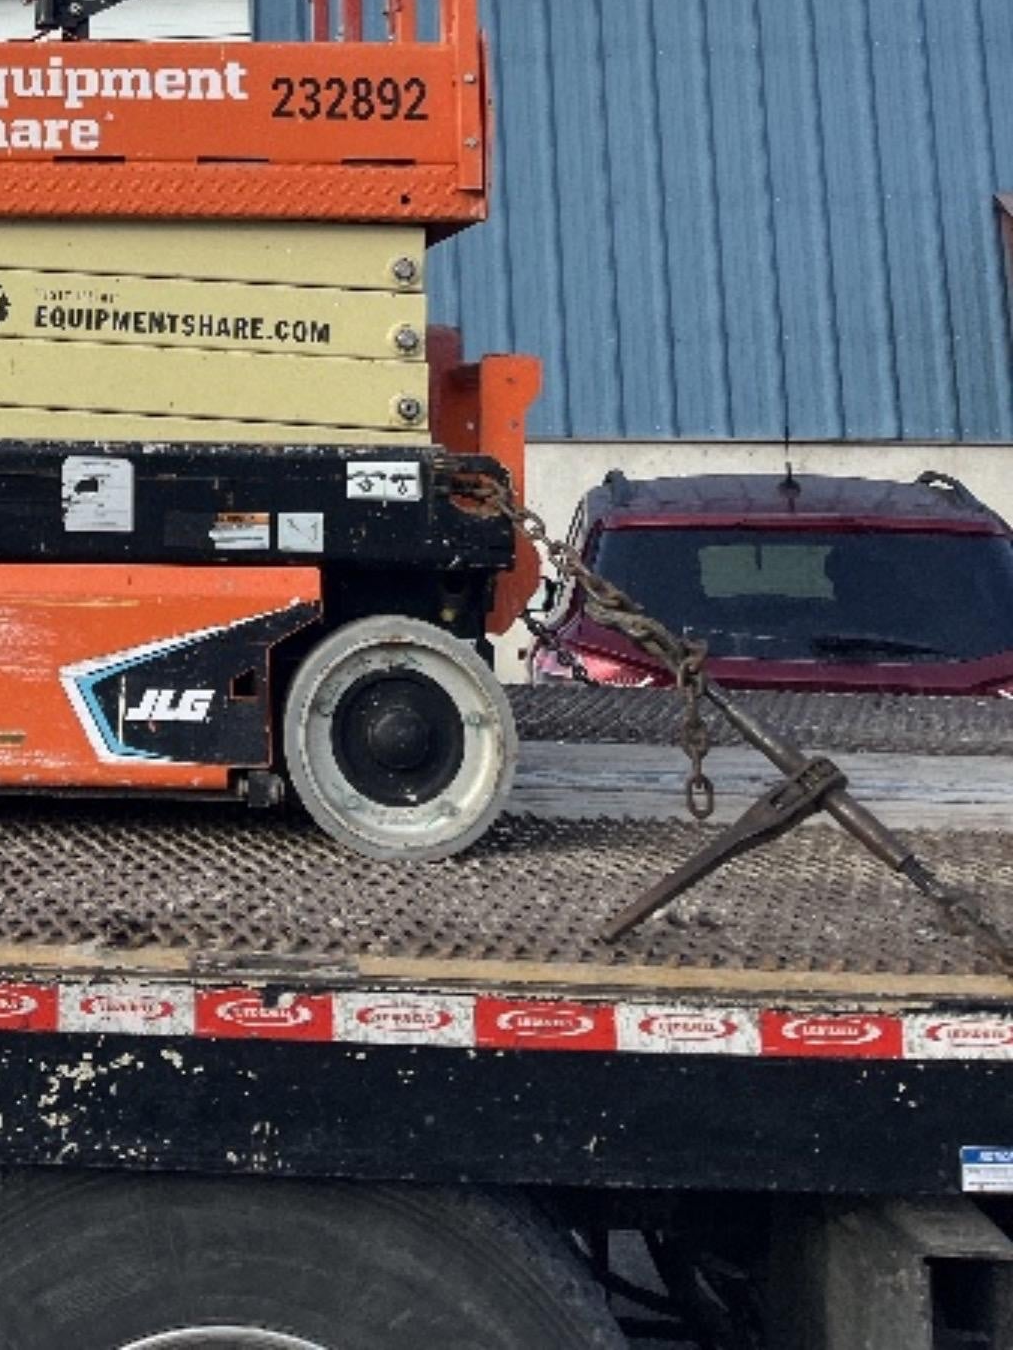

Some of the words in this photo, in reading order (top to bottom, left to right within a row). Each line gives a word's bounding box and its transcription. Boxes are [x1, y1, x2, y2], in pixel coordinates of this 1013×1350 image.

[271, 77, 429, 121] 232892
[34, 305, 331, 343] EQUIPMENTSHARE.COM
[124, 689, 216, 721] JLG
